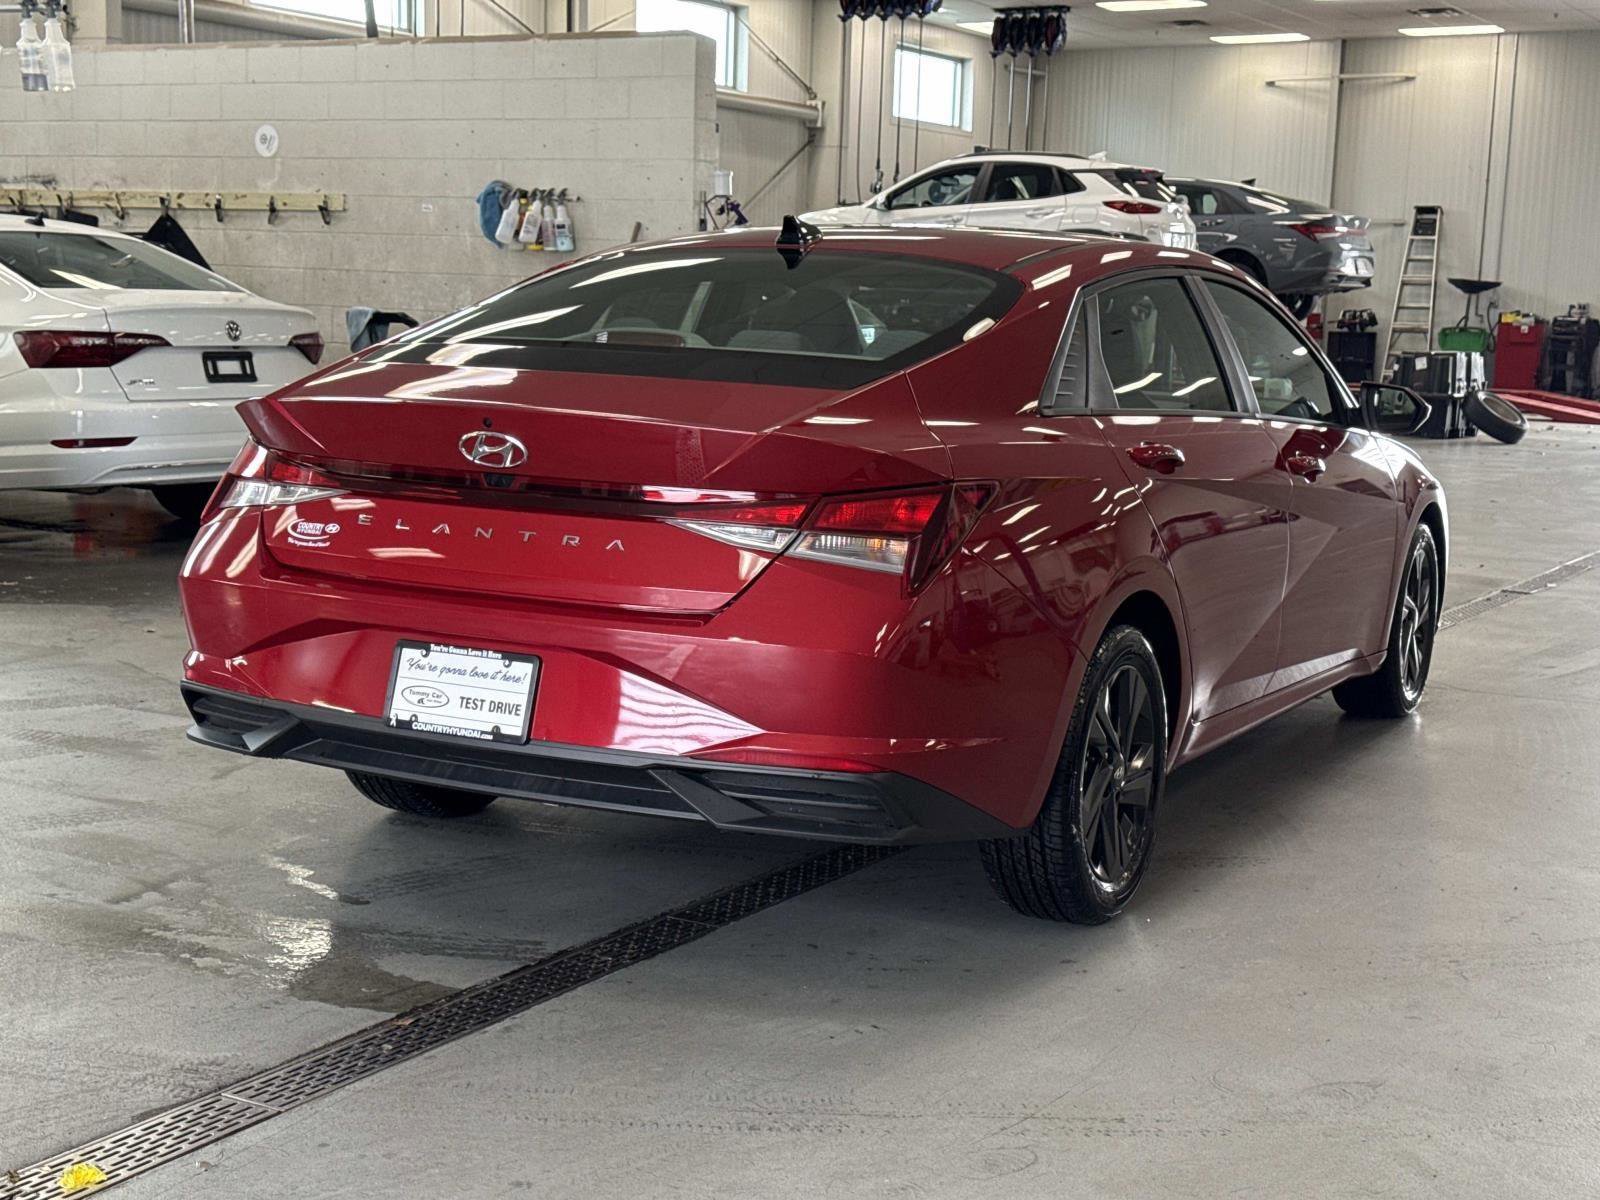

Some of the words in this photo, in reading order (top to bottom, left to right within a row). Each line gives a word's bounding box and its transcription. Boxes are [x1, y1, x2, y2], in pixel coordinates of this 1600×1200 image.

[357, 513, 625, 552] ELANTRA
[407, 657, 438, 671] You're
[438, 664, 468, 677] gonna
[469, 666, 489, 679] love
[490, 670, 502, 680] it
[501, 671, 528, 684] here!
[459, 696, 486, 711] TEST
[488, 700, 522, 717] DRIVE
